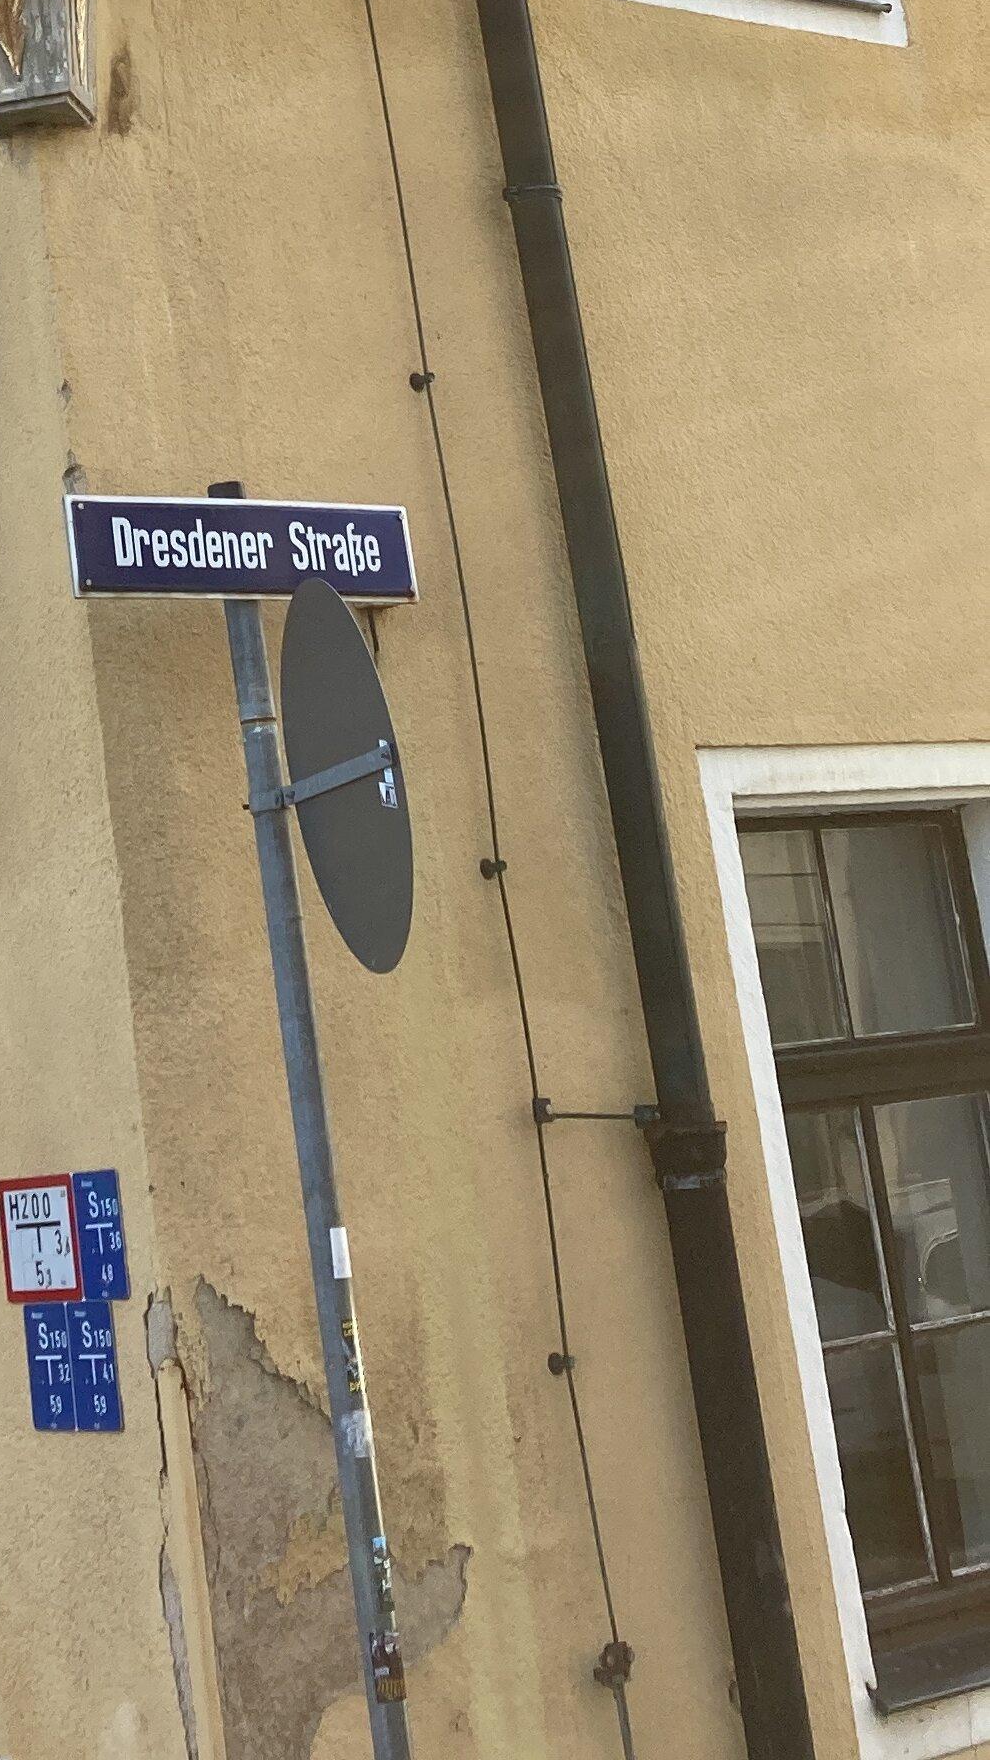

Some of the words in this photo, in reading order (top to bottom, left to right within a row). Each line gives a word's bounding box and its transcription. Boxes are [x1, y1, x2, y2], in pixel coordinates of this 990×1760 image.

[111, 516, 274, 570] Dresdener
[288, 521, 382, 577] Straße
[9, 1193, 51, 1221] H200
[88, 1191, 119, 1218] S150
[37, 1322, 68, 1350] S150
[81, 1320, 113, 1349] S150
